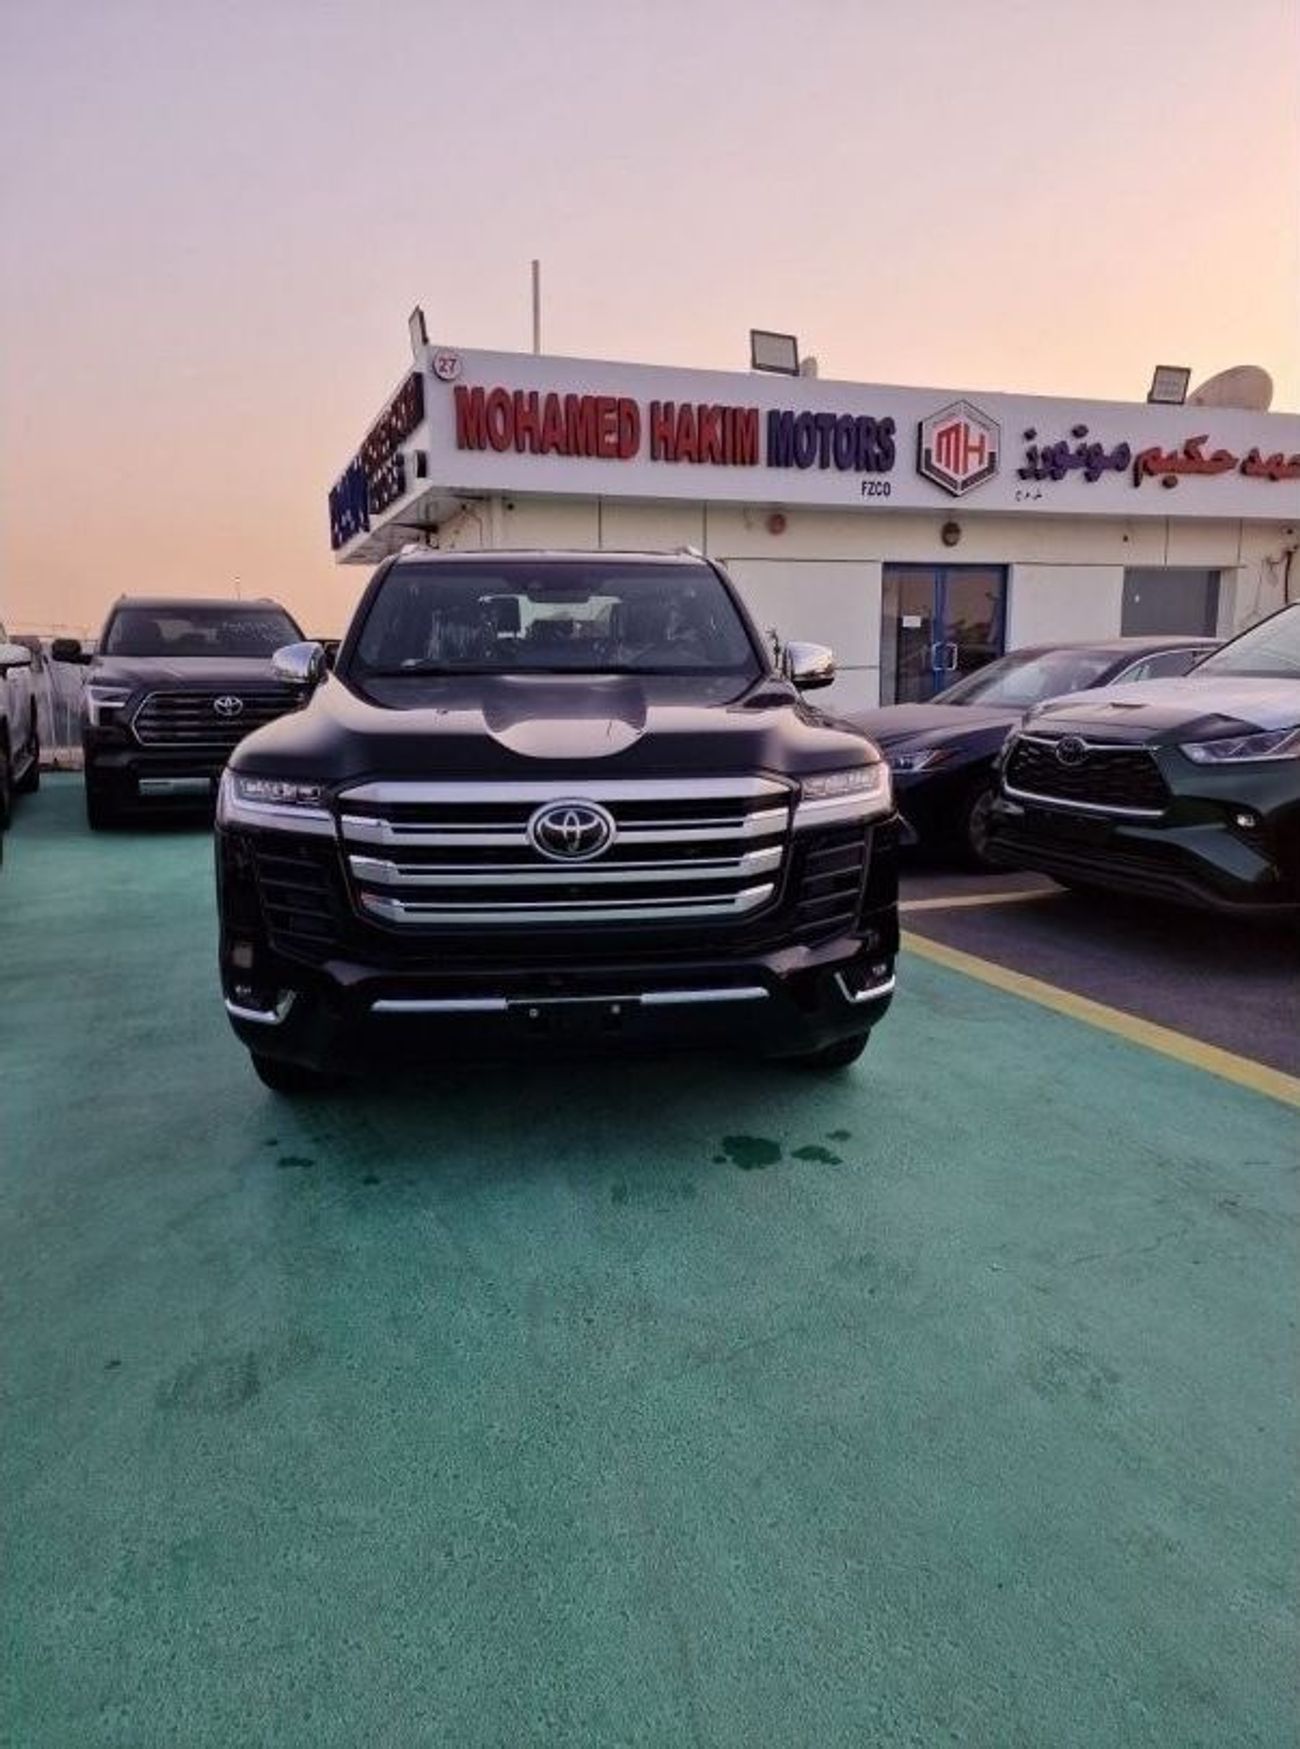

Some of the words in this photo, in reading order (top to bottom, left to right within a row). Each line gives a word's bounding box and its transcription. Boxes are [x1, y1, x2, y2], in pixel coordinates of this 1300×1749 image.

[438, 357, 458, 375] 27
[454, 386, 640, 460] MOHAMED
[650, 400, 760, 466] HAKIM
[767, 408, 896, 474] MOTORS
[1016, 424, 1132, 483] موتورز
[1133, 434, 1239, 488] حكيم
[861, 480, 892, 498] FZCO
